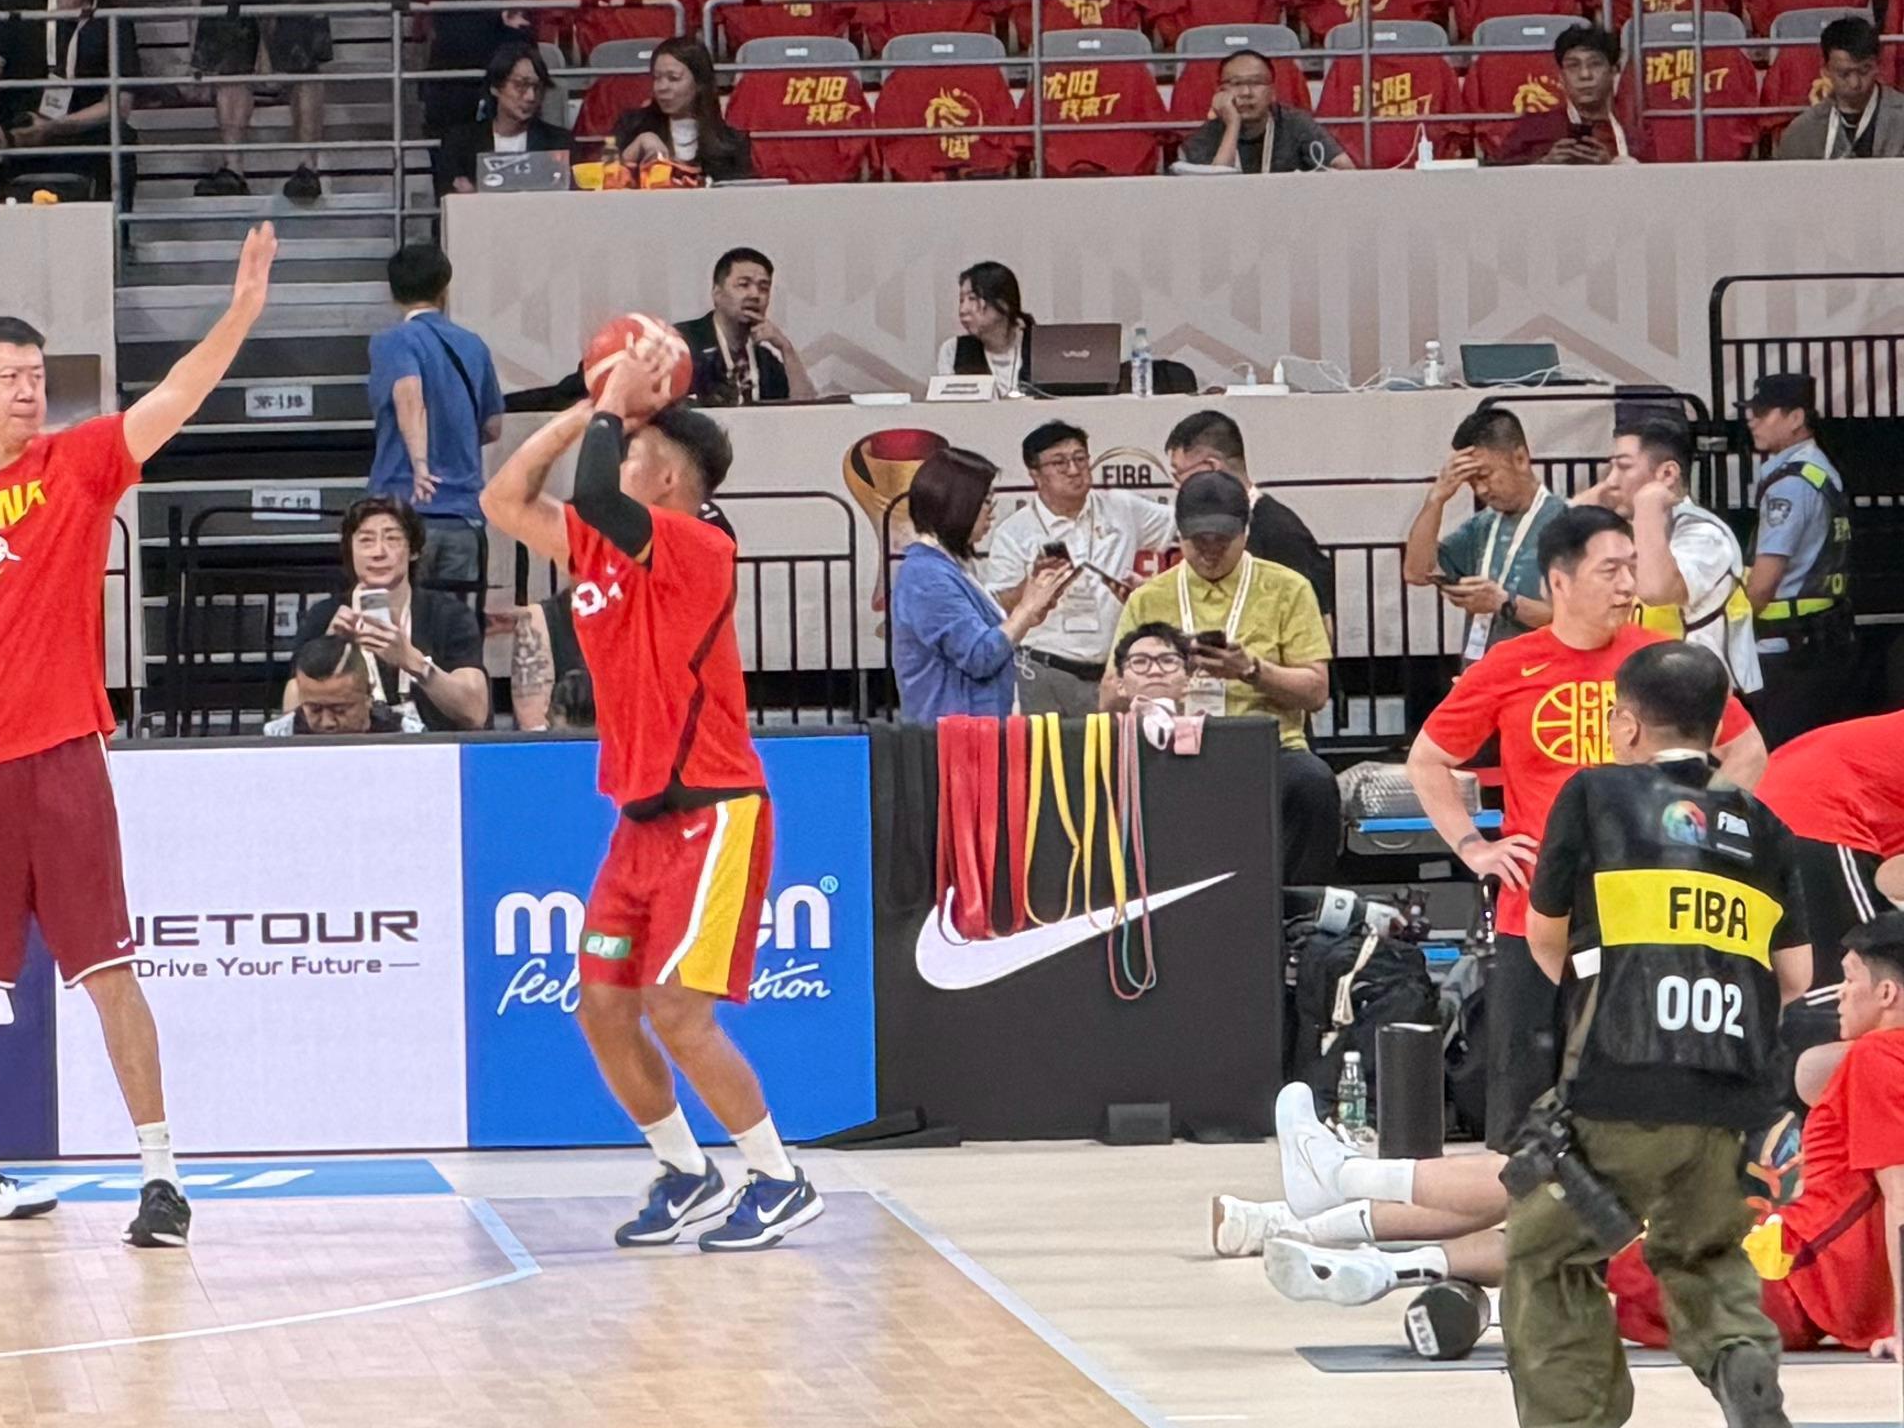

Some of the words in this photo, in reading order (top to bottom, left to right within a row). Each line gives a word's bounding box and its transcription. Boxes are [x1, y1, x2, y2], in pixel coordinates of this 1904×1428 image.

[788, 76, 847, 104] 沈阳
[1043, 69, 1098, 101] 沈阳
[1102, 464, 1152, 485] FIBA
[1669, 885, 1749, 942] FIBA
[137, 955, 210, 980] Drive
[217, 956, 279, 978] Your
[291, 954, 382, 978] Future
[1655, 974, 1745, 1039] 002
